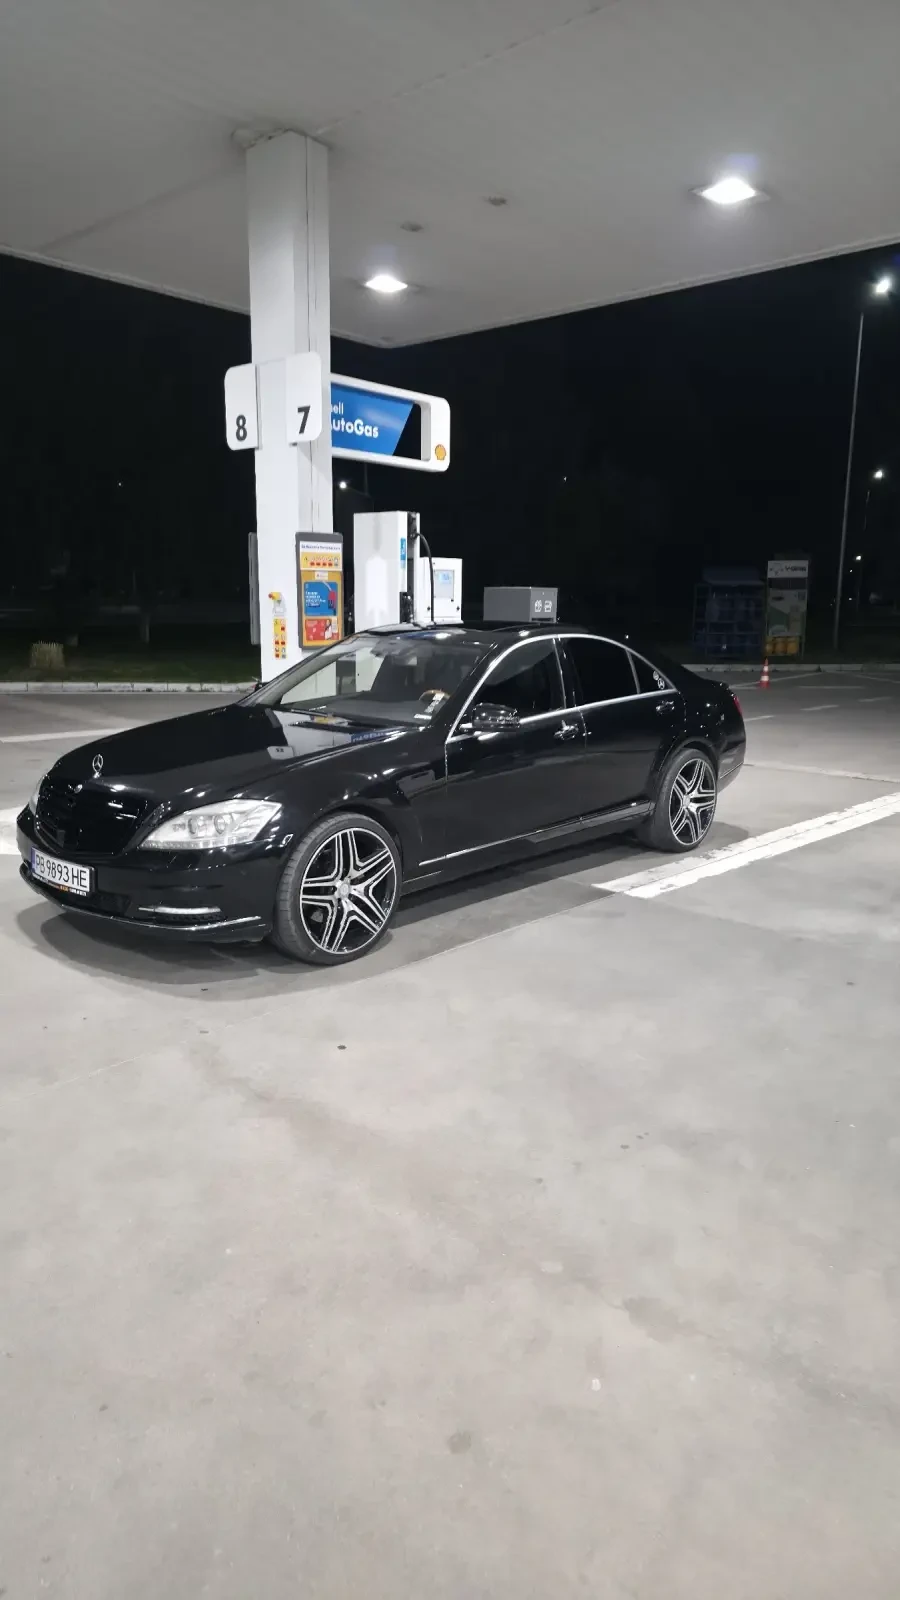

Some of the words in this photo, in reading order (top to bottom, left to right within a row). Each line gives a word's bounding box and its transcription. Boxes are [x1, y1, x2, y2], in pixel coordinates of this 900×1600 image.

[297, 405, 311, 434] 7
[331, 401, 344, 415] ell
[235, 414, 247, 441] 8
[330, 417, 379, 438] utoGas
[46, 860, 69, 883] 9893
